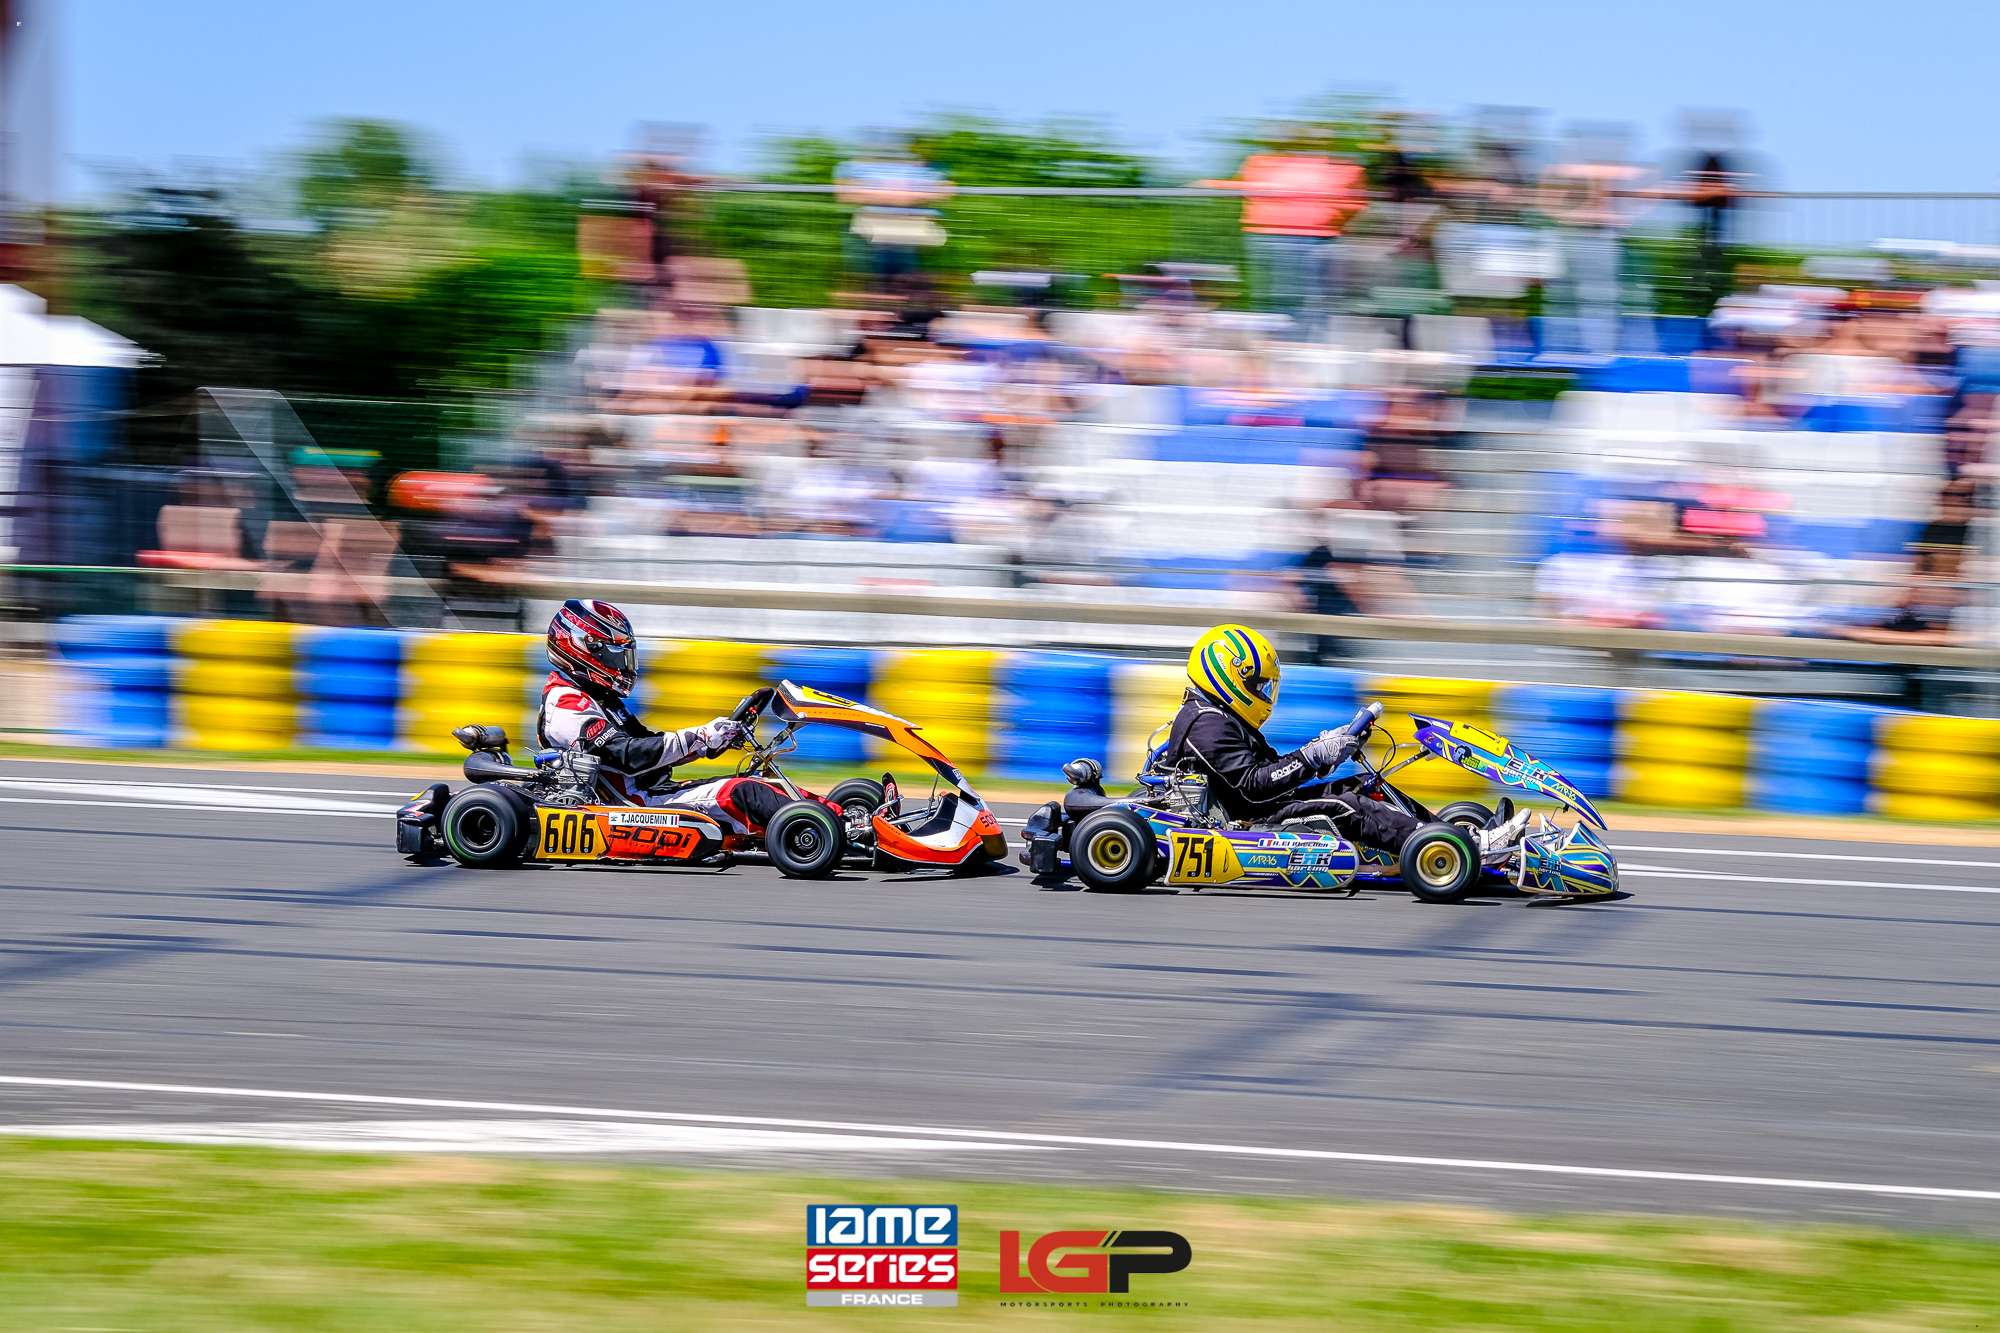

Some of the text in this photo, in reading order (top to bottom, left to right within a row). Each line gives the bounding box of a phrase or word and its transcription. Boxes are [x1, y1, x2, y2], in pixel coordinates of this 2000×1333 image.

[545, 814, 595, 854] 606
[621, 814, 668, 825] T.JACQUEMIN
[1174, 837, 1214, 877] 751
